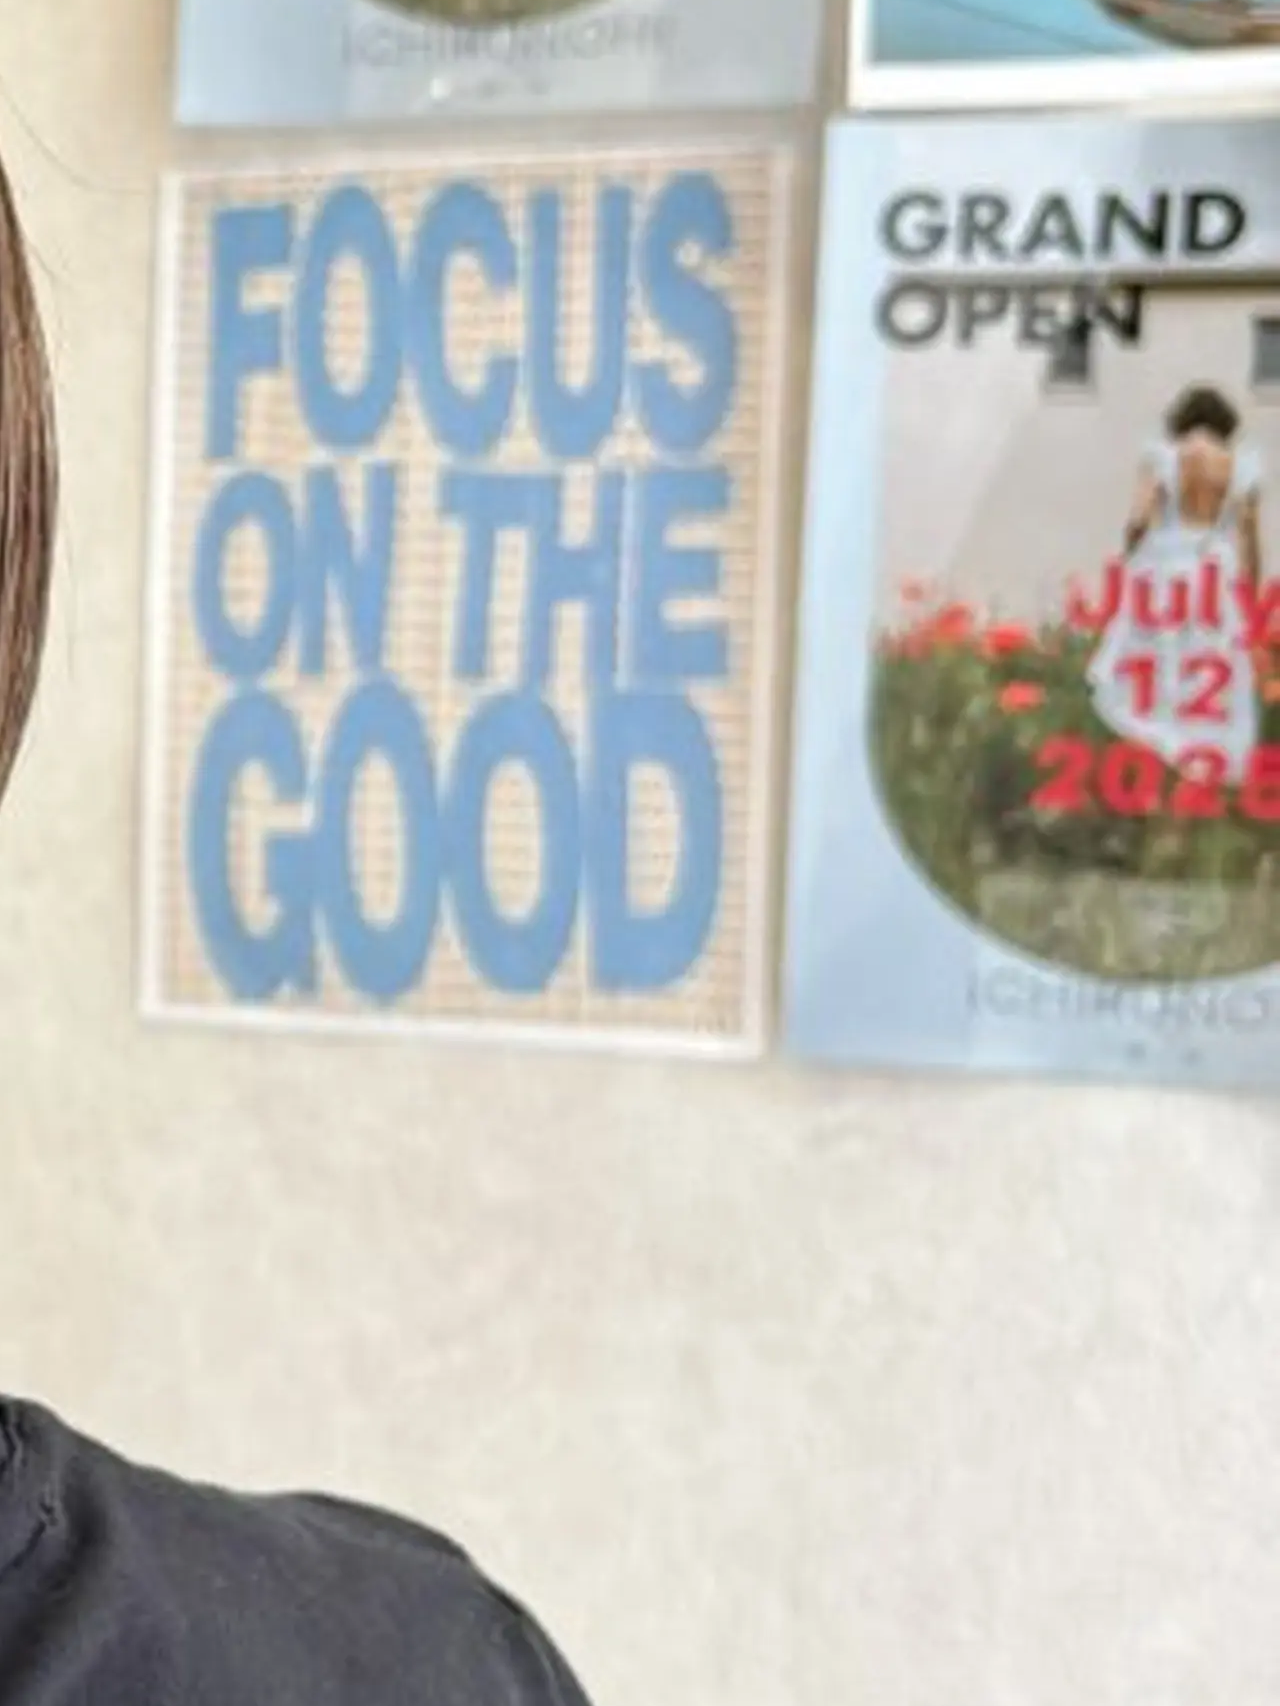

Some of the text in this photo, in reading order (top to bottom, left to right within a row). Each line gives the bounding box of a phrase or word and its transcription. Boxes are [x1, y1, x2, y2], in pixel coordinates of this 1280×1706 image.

[879, 190, 1248, 259] GRAND
[206, 170, 737, 460] FOCUS
[876, 282, 1148, 348] OPEN
[196, 465, 732, 679] ON THE
[1070, 557, 1280, 651] July
[1116, 653, 1232, 723] 12
[1033, 737, 1280, 821] 2025
[188, 673, 724, 1001] GOOD
